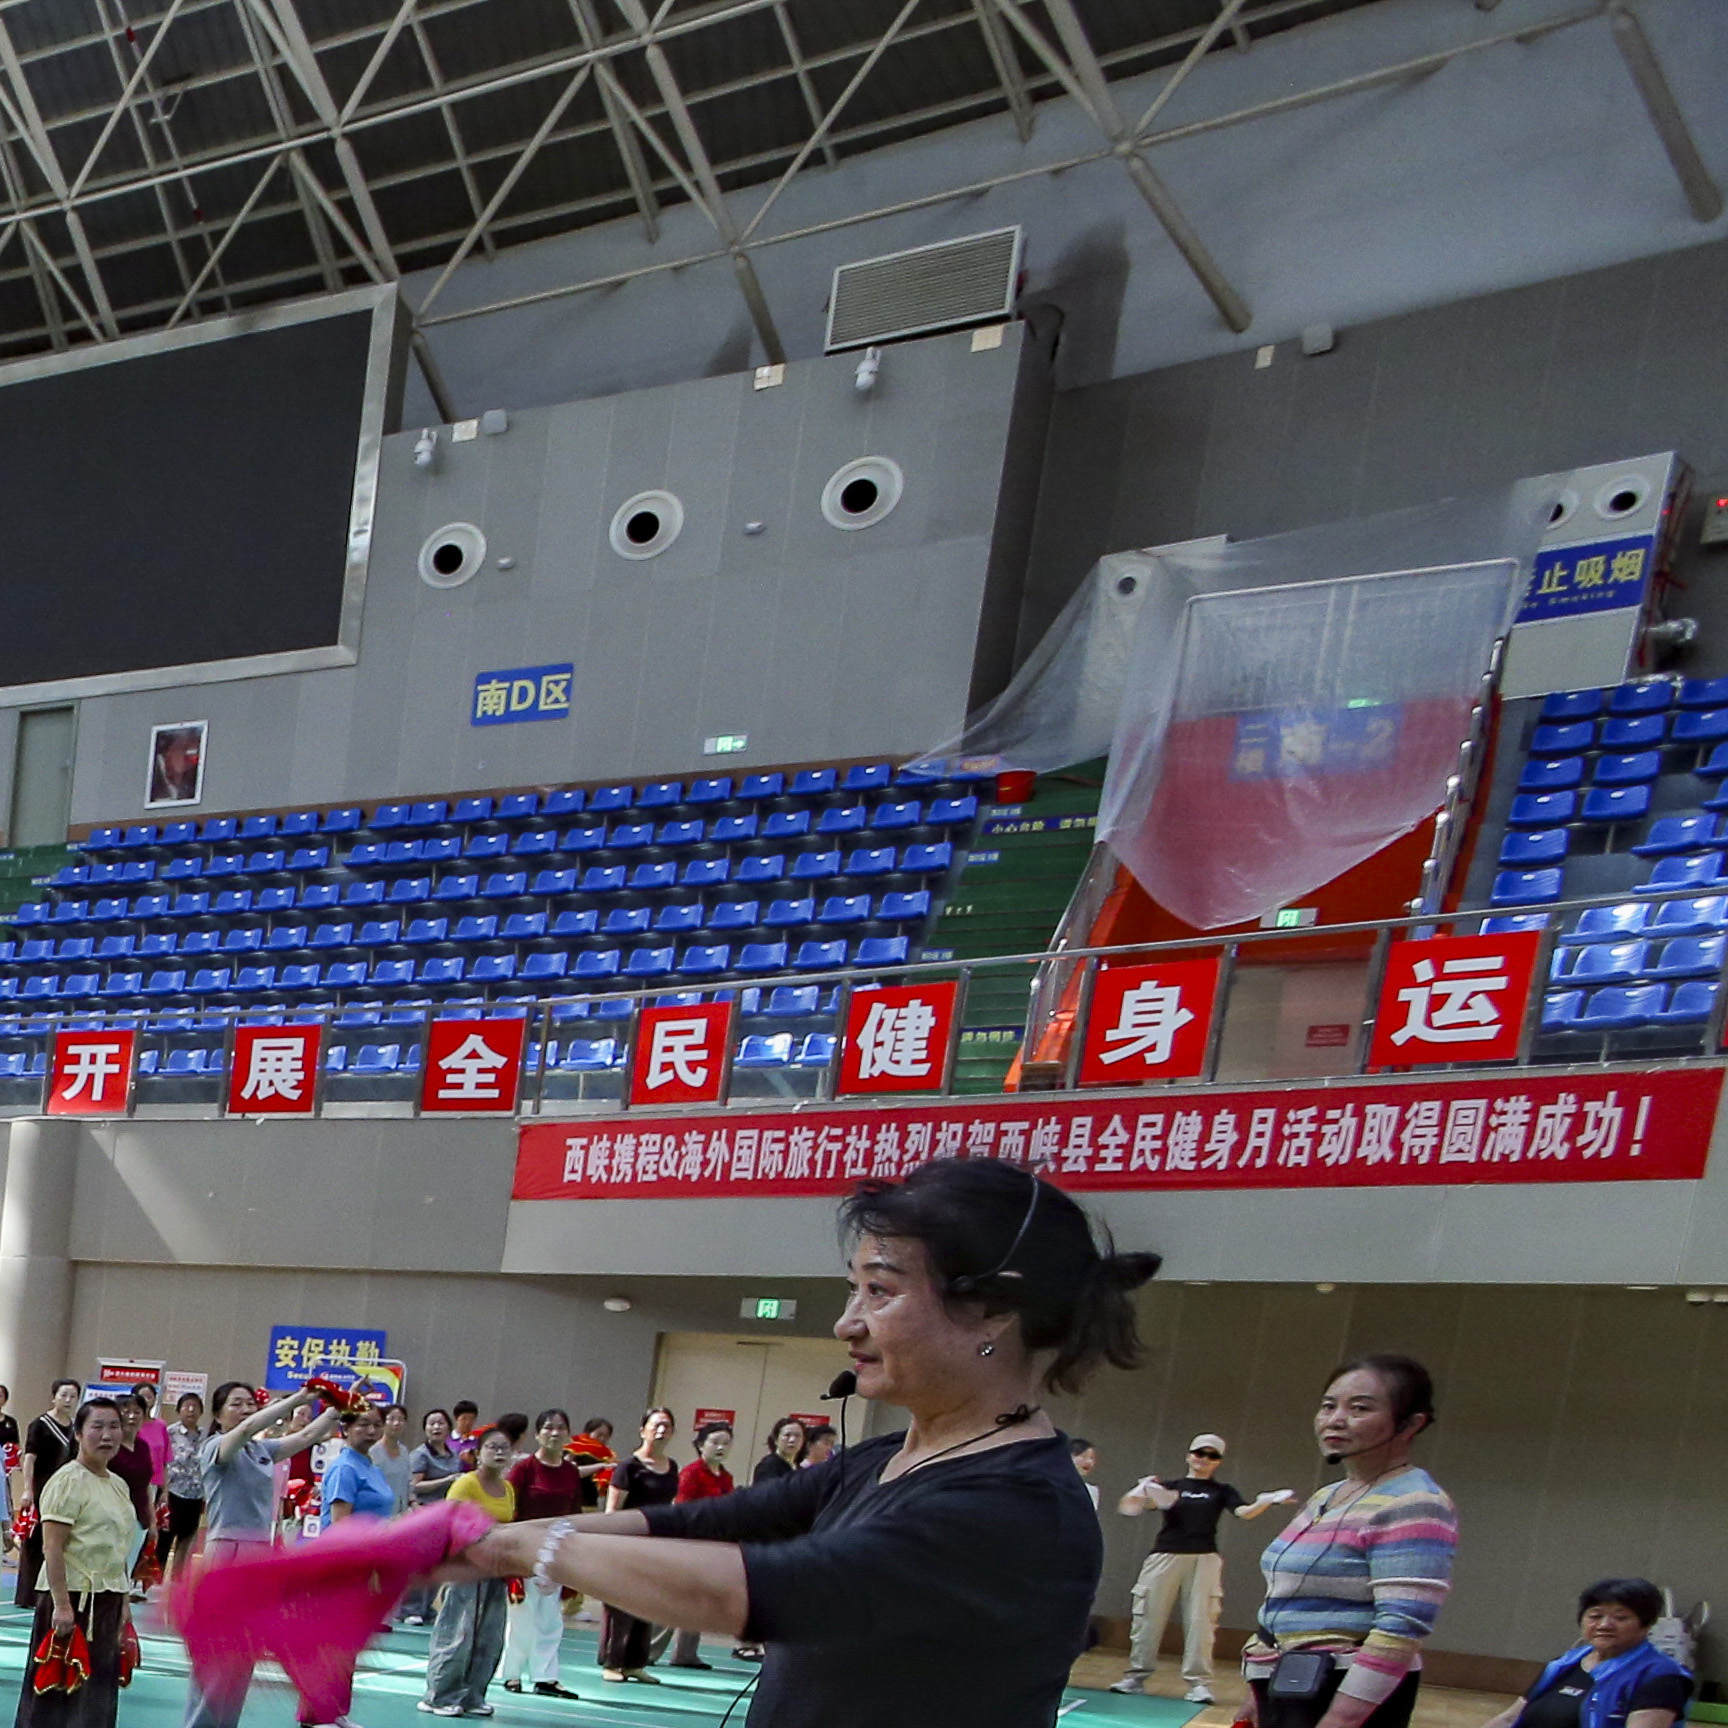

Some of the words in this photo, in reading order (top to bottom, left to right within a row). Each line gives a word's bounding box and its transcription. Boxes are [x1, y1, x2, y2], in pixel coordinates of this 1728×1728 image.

[476, 672, 572, 719] 南D区
[61, 1044, 121, 1101] 开
[240, 1037, 306, 1101] 展
[437, 1033, 508, 1100] 全
[645, 1017, 710, 1089] 民
[855, 998, 937, 1080] 健
[1098, 979, 1195, 1066] 身
[1390, 953, 1510, 1047] 运
[275, 1336, 380, 1369] 安保执勤
